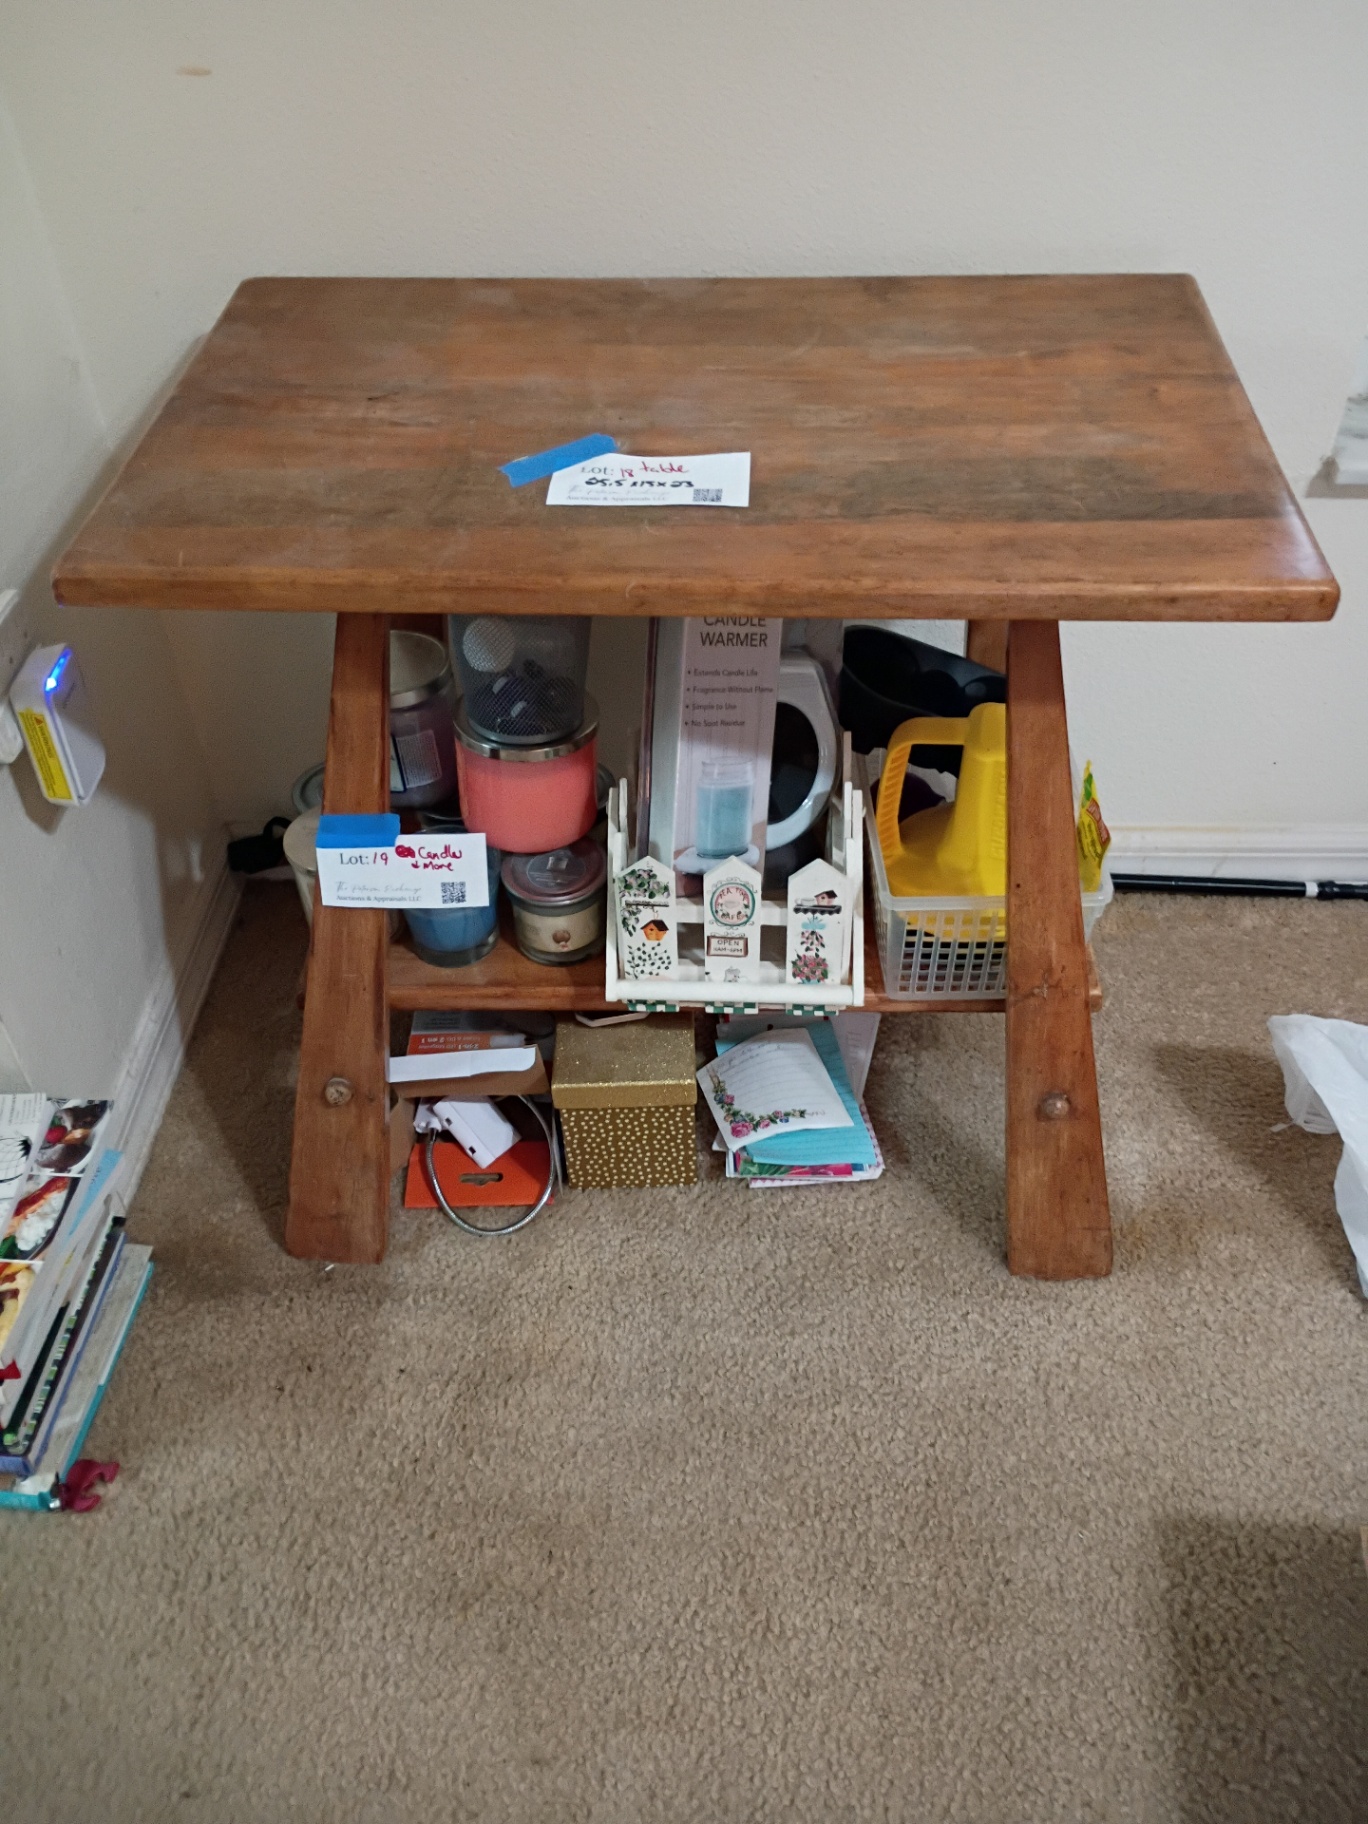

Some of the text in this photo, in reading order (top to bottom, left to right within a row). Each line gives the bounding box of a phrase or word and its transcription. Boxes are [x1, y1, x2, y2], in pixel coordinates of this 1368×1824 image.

[581, 466, 614, 476] Lot:
[703, 616, 767, 627] CANDLE
[700, 631, 768, 648] WARMER
[694, 667, 758, 676] Extends Candle Life
[693, 685, 726, 695] Fragrance
[727, 685, 753, 694] Without
[725, 702, 737, 710] Use
[340, 852, 369, 865] Lot:
[373, 851, 388, 866] 19
[423, 860, 454, 872] More
[373, 895, 407, 903] Appraisals
